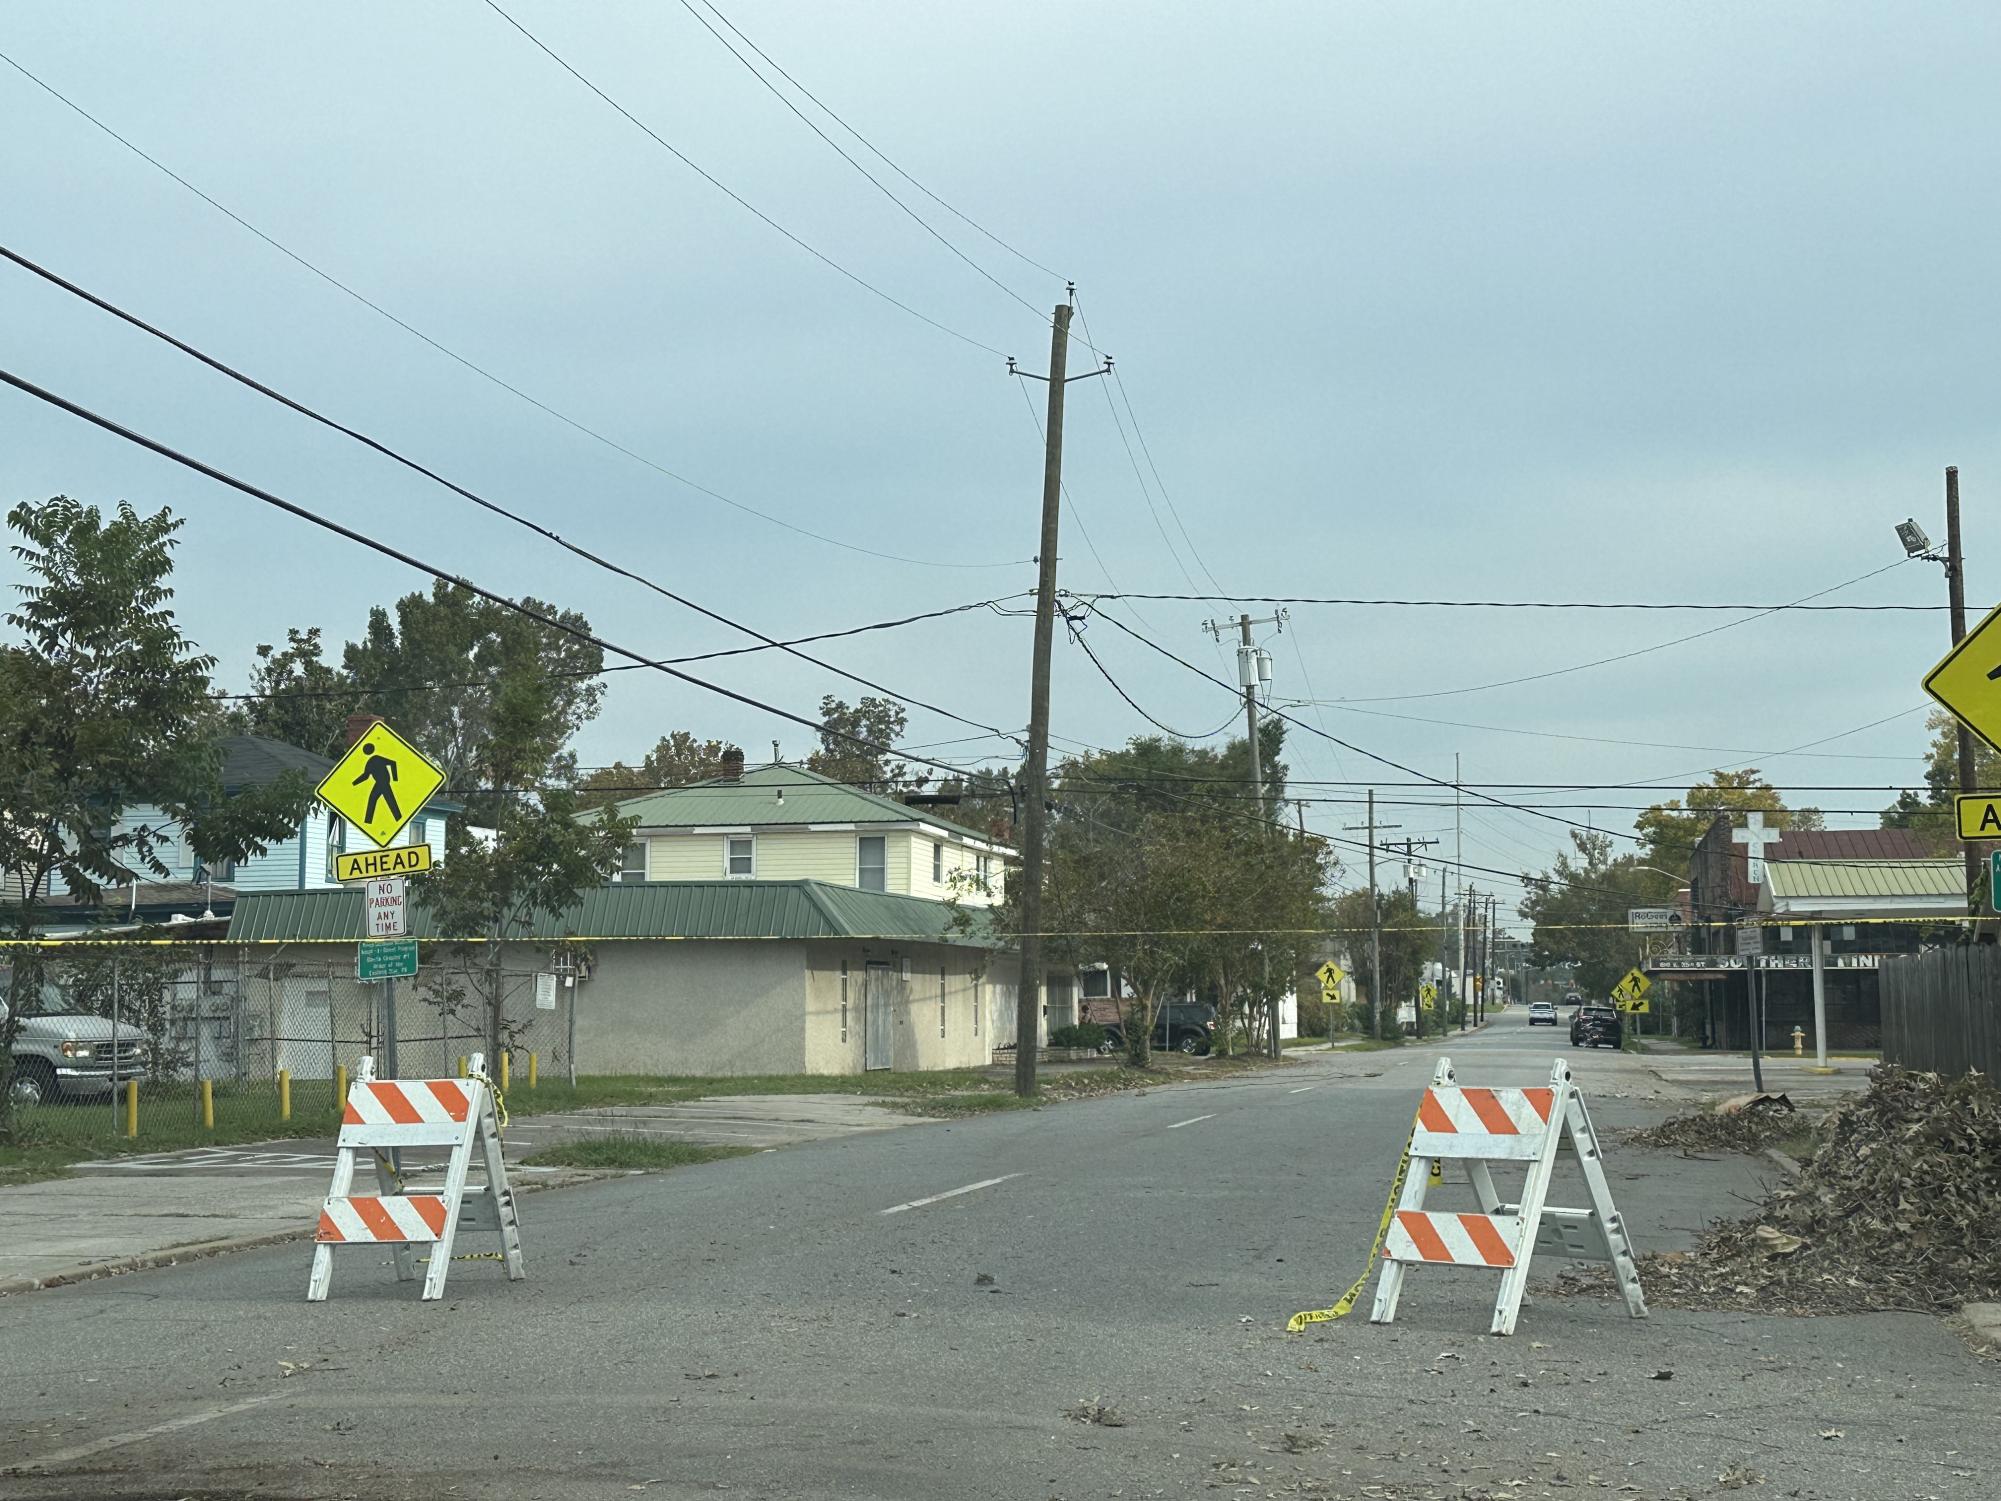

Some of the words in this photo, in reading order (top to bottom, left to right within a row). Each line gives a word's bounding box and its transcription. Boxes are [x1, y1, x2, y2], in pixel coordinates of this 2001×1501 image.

[349, 851, 420, 876] AHEAD
[378, 883, 393, 895] NO
[368, 895, 403, 909] PARKING
[376, 910, 395, 921] ANY
[375, 921, 398, 933] TIME
